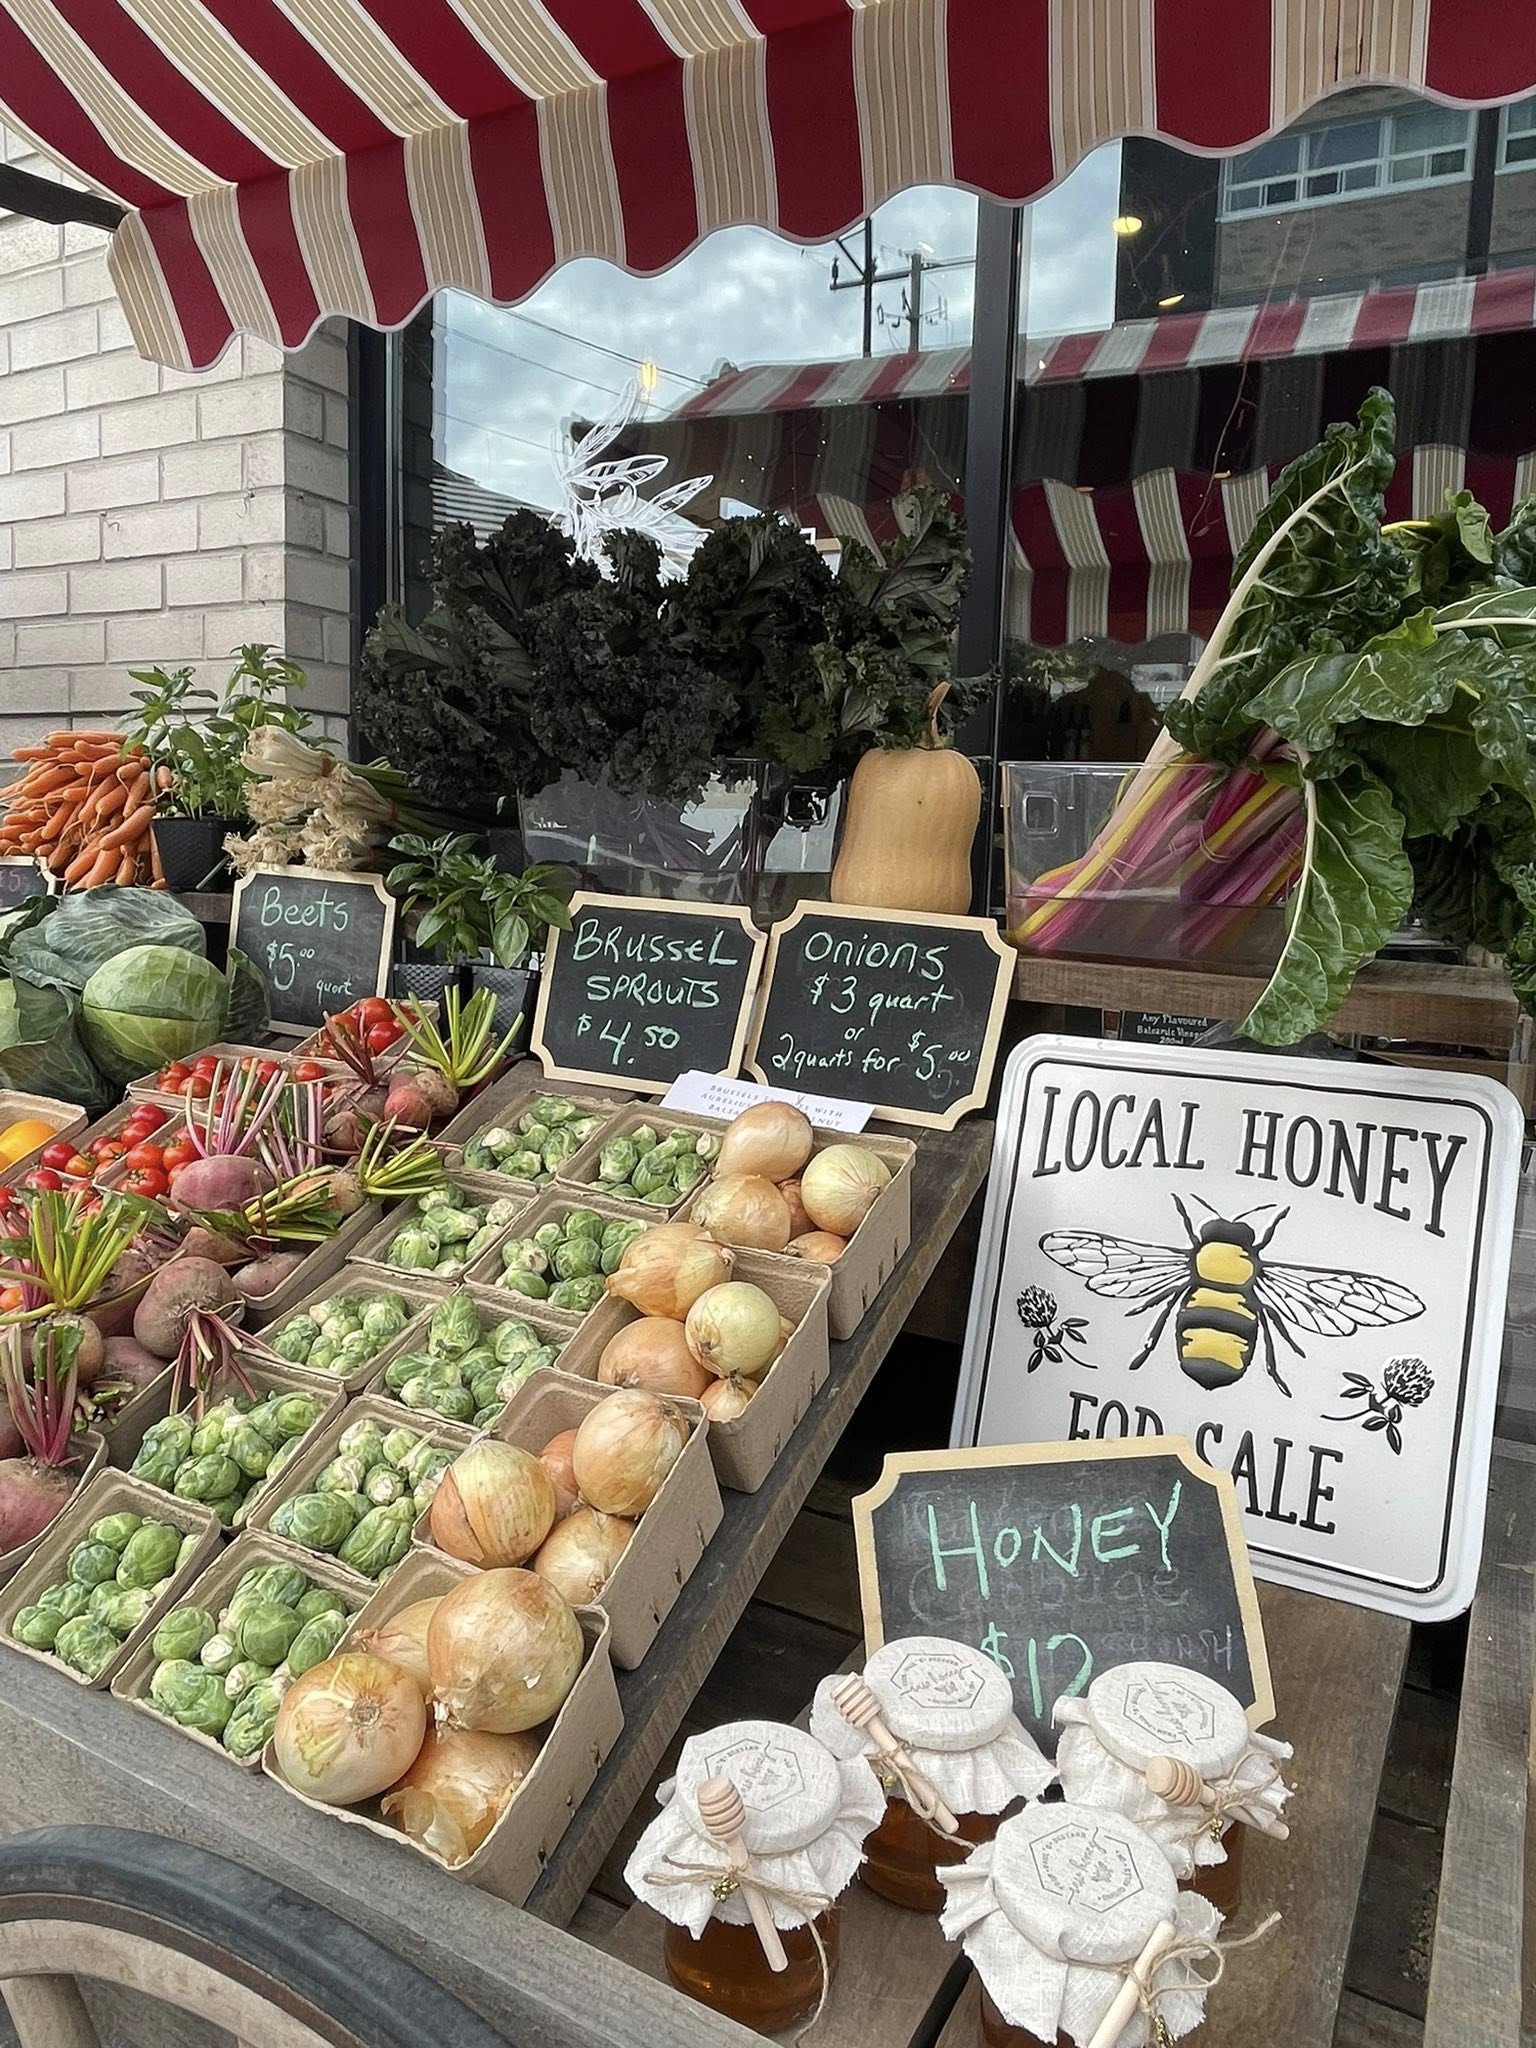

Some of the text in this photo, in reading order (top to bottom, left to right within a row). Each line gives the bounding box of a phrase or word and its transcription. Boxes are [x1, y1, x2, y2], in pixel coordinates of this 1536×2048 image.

[260, 885, 349, 931] Beets
[572, 918, 739, 965] BRUSSEL
[804, 931, 949, 981] Onions
[586, 972, 720, 1008] SPROUTS
[868, 984, 954, 1027] quart
[844, 1026, 865, 1041] or
[1137, 1025, 1204, 1039] Balsamic Vineg
[1142, 1013, 1161, 1025] Any
[862, 1048, 900, 1073] for
[710, 1085, 843, 1118] BRUSSELS WITH
[1032, 1085, 1468, 1238] LOCAL HONEY
[1195, 1421, 1344, 1534] SALE
[927, 1480, 1183, 1600] HONEY
